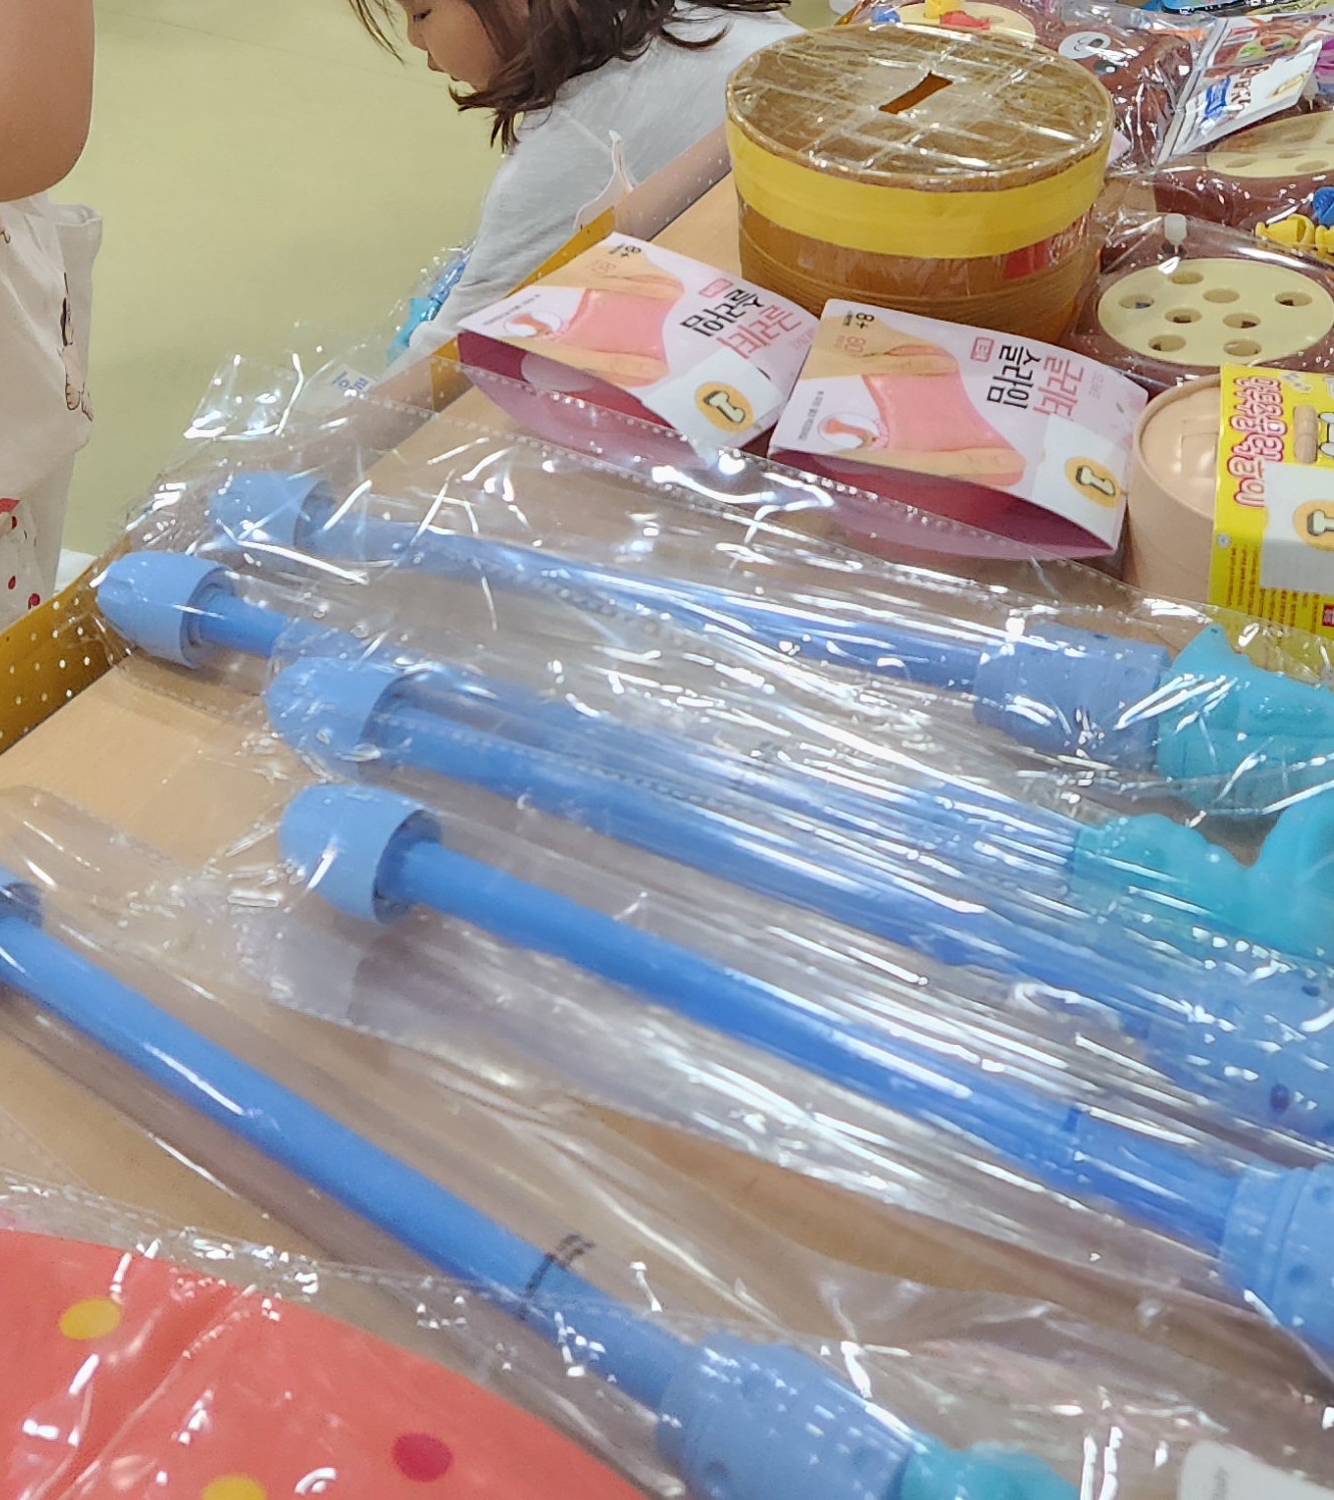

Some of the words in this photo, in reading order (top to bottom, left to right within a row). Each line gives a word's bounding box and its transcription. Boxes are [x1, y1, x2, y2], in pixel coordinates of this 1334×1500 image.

[680, 286, 765, 338] 슬라임
[855, 310, 876, 331] 8+
[986, 343, 1043, 410] 슬라임
[1033, 353, 1085, 423] 글리터
